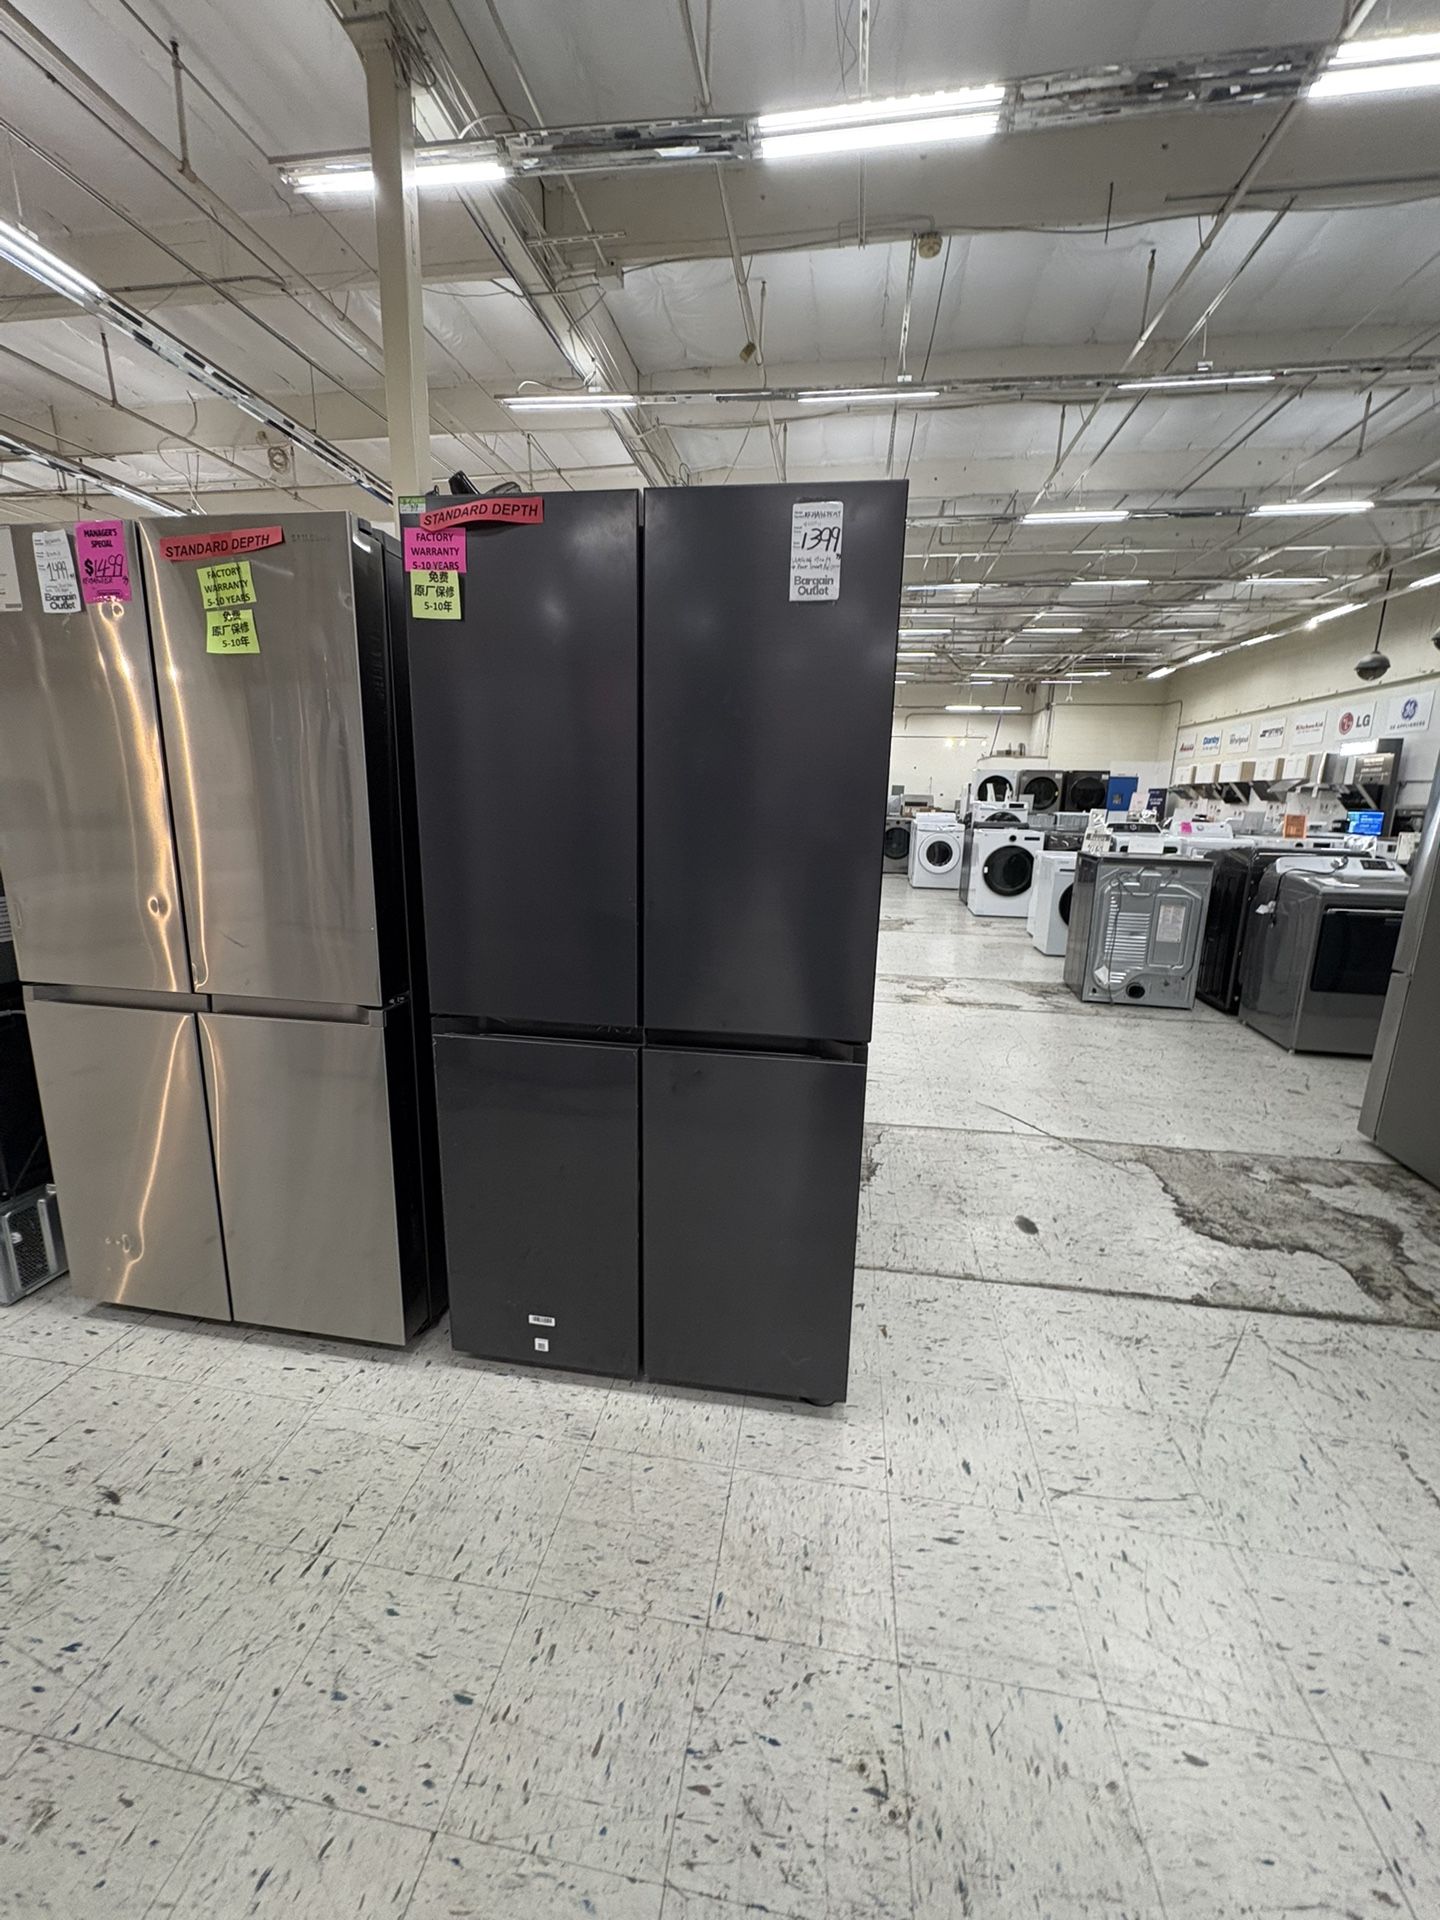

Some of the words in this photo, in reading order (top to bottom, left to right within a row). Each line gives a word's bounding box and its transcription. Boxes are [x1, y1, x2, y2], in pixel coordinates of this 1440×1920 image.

[423, 504, 488, 526] STANDARD
[492, 503, 538, 517] DEPTH
[84, 528, 117, 537] MANAGER'S
[416, 533, 454, 542] FACTORY
[91, 540, 113, 548] SPECIAL
[165, 540, 228, 558] STANDARD
[231, 534, 270, 550] DEPTH
[801, 527, 841, 553] 1399
[411, 547, 460, 556] WARRANTY
[47, 561, 68, 581] 1499
[412, 562, 431, 570] 5-10
[433, 562, 459, 570] YEARS
[207, 567, 241, 579] FACTORY
[428, 571, 449, 583] 免费
[204, 579, 248, 593] WARRANTY
[794, 575, 834, 586] Bargain
[414, 585, 455, 598] 原厂保修
[798, 585, 829, 596] Outlet
[45, 592, 77, 603] Bargain
[207, 597, 225, 607] 5-10
[226, 593, 250, 605] YEARS
[50, 601, 76, 610] Outlet
[424, 601, 452, 613] 5-10年
[223, 610, 241, 622] 免费
[212, 622, 250, 636] 原厂保修
[222, 636, 250, 648] 5-10年
[1356, 714, 1371, 728] LG
[1202, 736, 1220, 746] Danby
